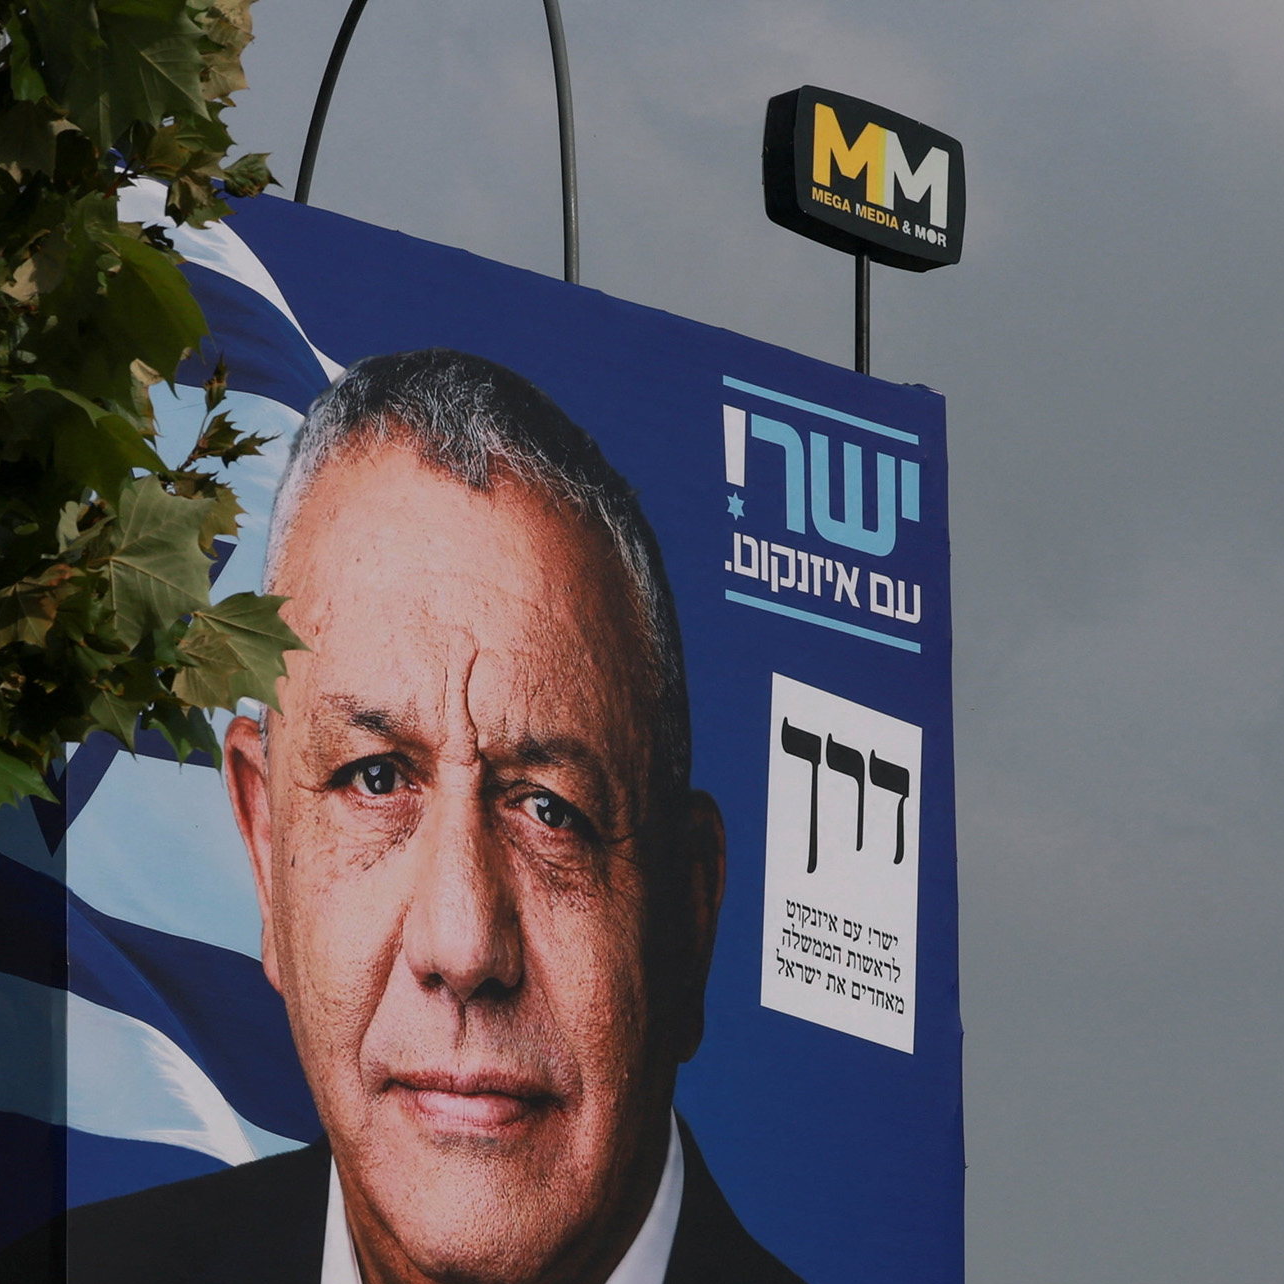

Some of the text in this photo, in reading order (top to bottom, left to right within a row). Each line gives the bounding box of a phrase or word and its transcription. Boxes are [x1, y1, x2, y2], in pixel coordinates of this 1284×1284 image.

[812, 101, 949, 229] MM
[811, 186, 947, 248] MEGA MEDIA & MOR
[722, 403, 921, 558] ישר!
[724, 531, 921, 625] עם איזנקוט.
[781, 716, 910, 874] דרך
[781, 926, 901, 984] לראשות הממשלה
[786, 898, 899, 949] ישר! עם איזנקוט
[776, 949, 905, 1015] מאחדים את ישראל
